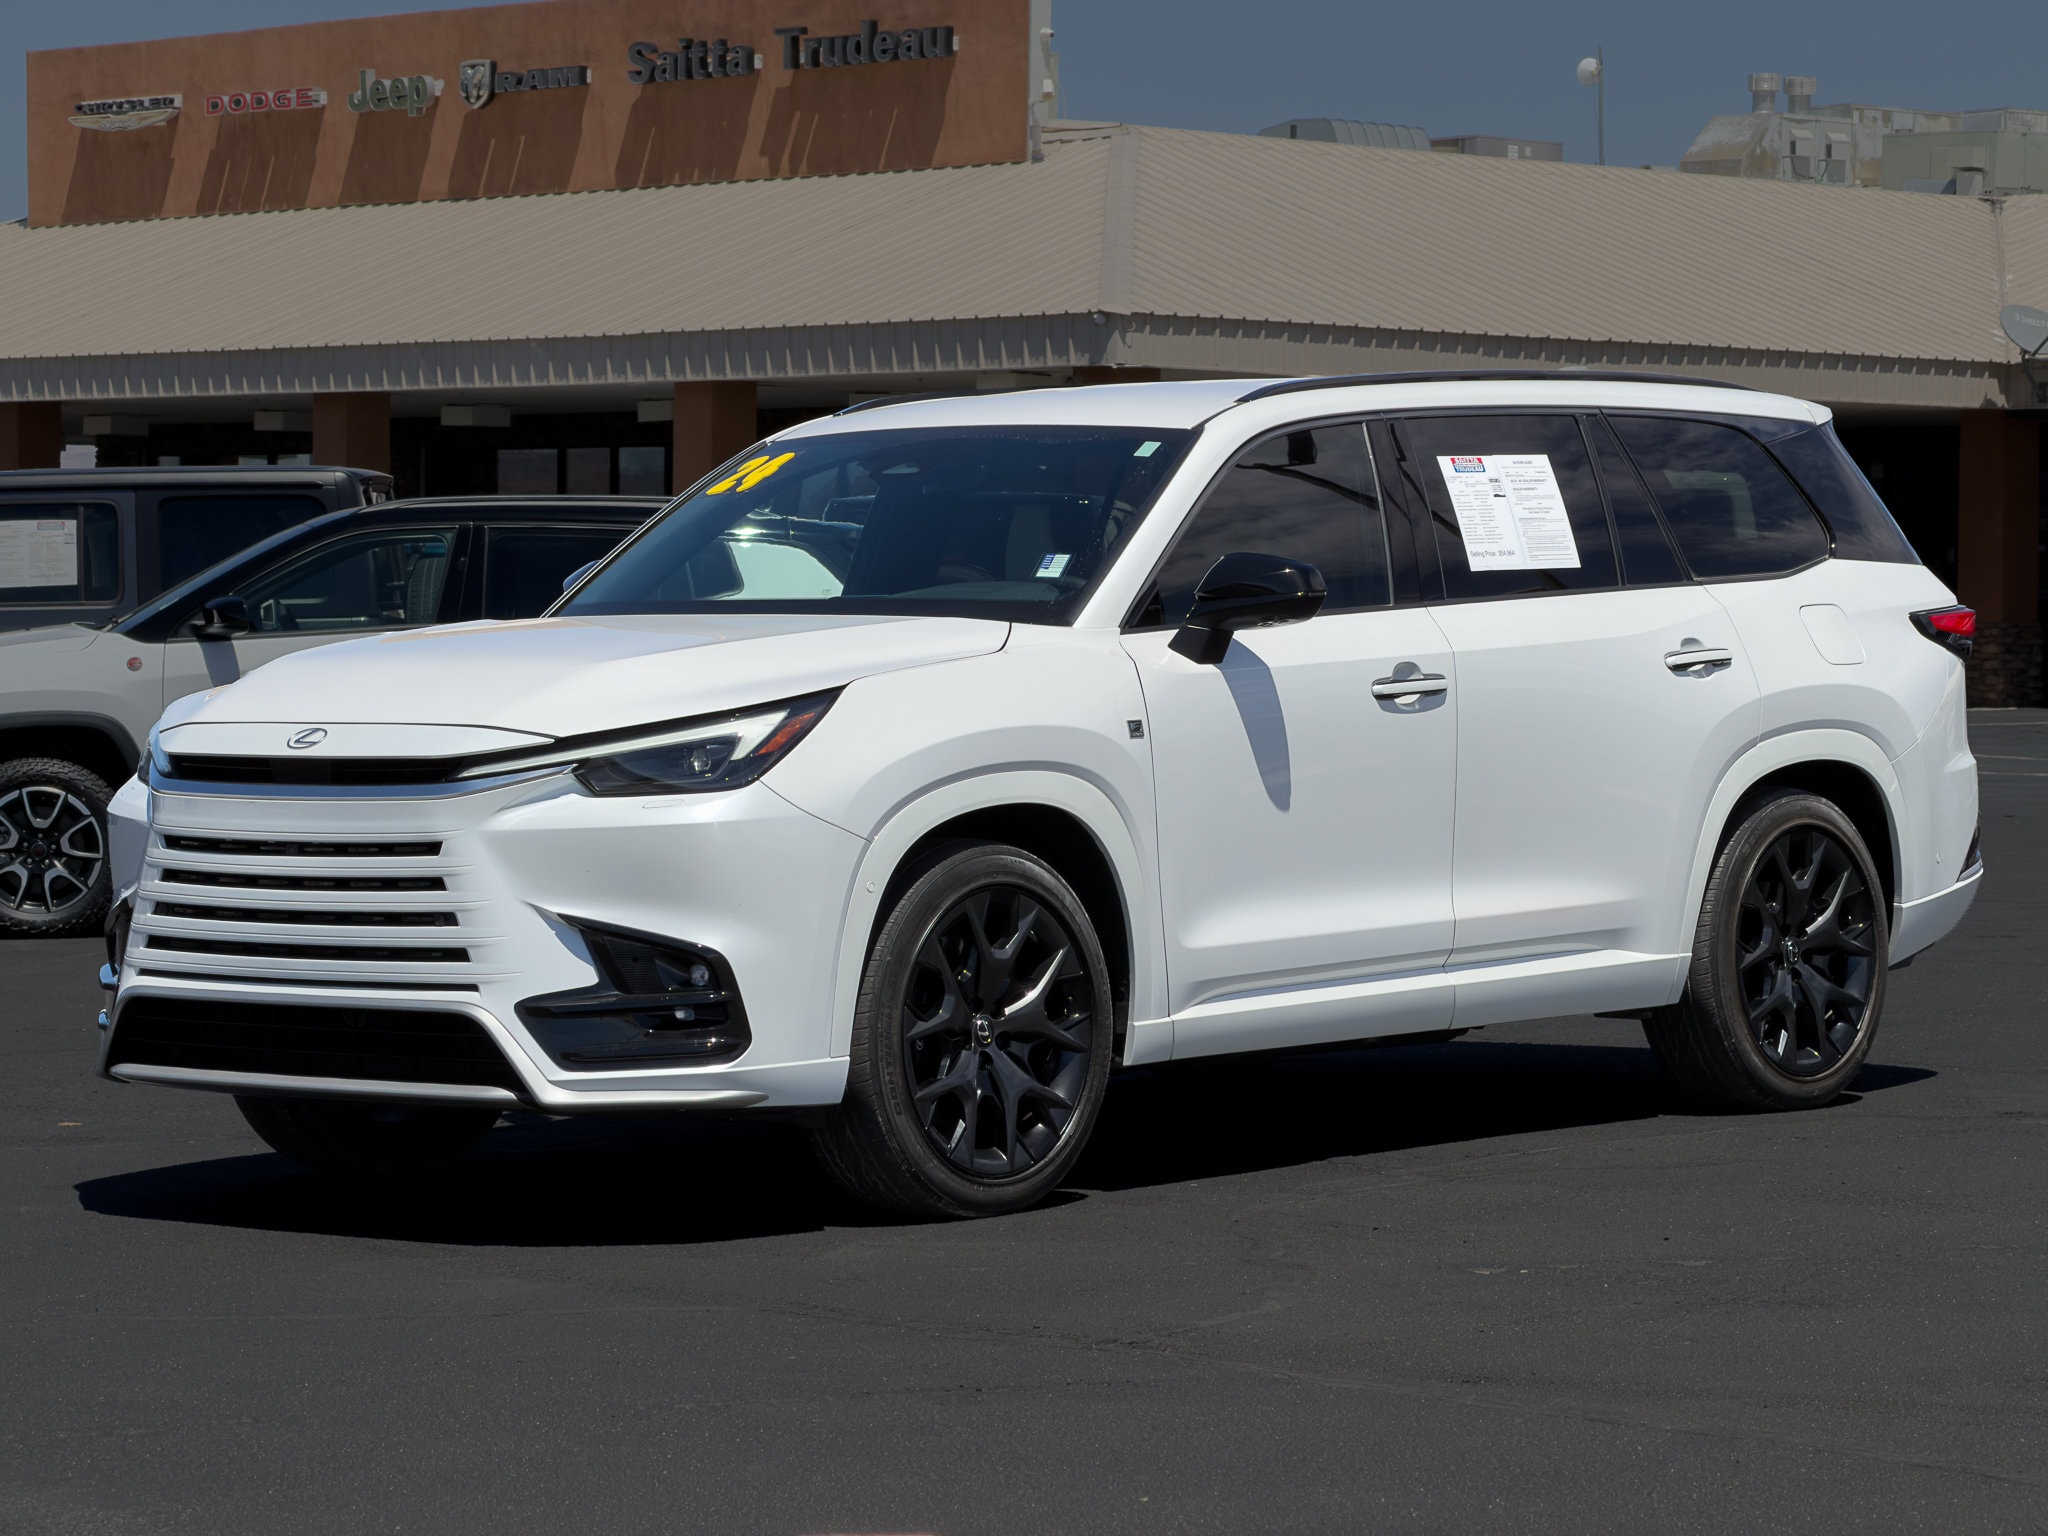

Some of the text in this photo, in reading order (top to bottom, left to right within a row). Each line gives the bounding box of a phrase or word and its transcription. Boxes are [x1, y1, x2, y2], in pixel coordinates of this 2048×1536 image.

[628, 19, 954, 85] Saitta Trudeau
[347, 68, 434, 117] Jeep
[494, 65, 588, 93] RAM
[205, 87, 316, 116] DODGE
